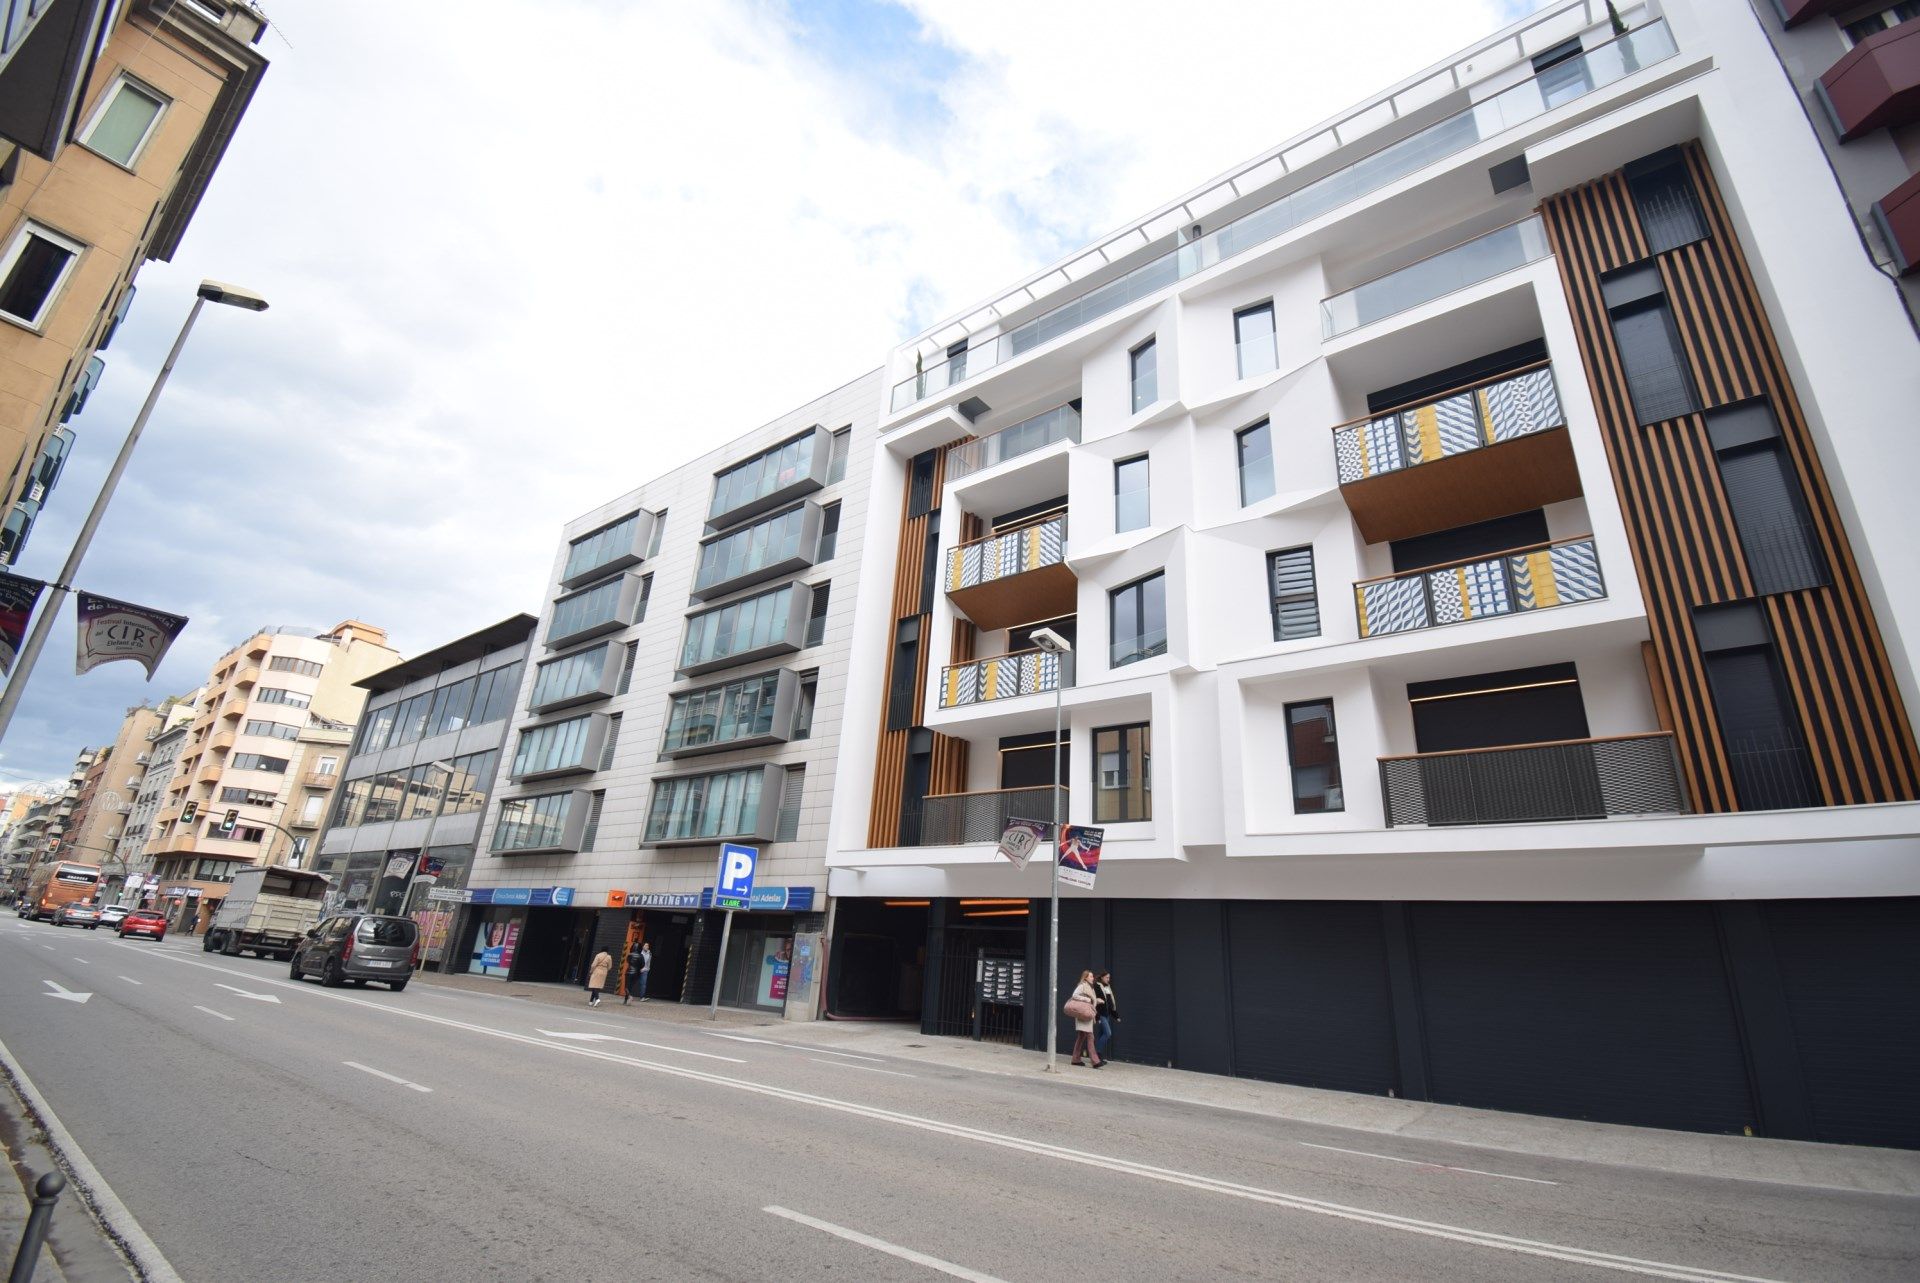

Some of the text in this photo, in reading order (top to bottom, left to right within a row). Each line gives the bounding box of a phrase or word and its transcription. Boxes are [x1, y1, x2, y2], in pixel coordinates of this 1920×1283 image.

[87, 603, 104, 611] de
[107, 625, 159, 649] CIRC
[1008, 832, 1031, 850] CIRC
[722, 851, 753, 890] P
[641, 895, 680, 905] PARKING
[751, 893, 781, 902] tal Adeslas
